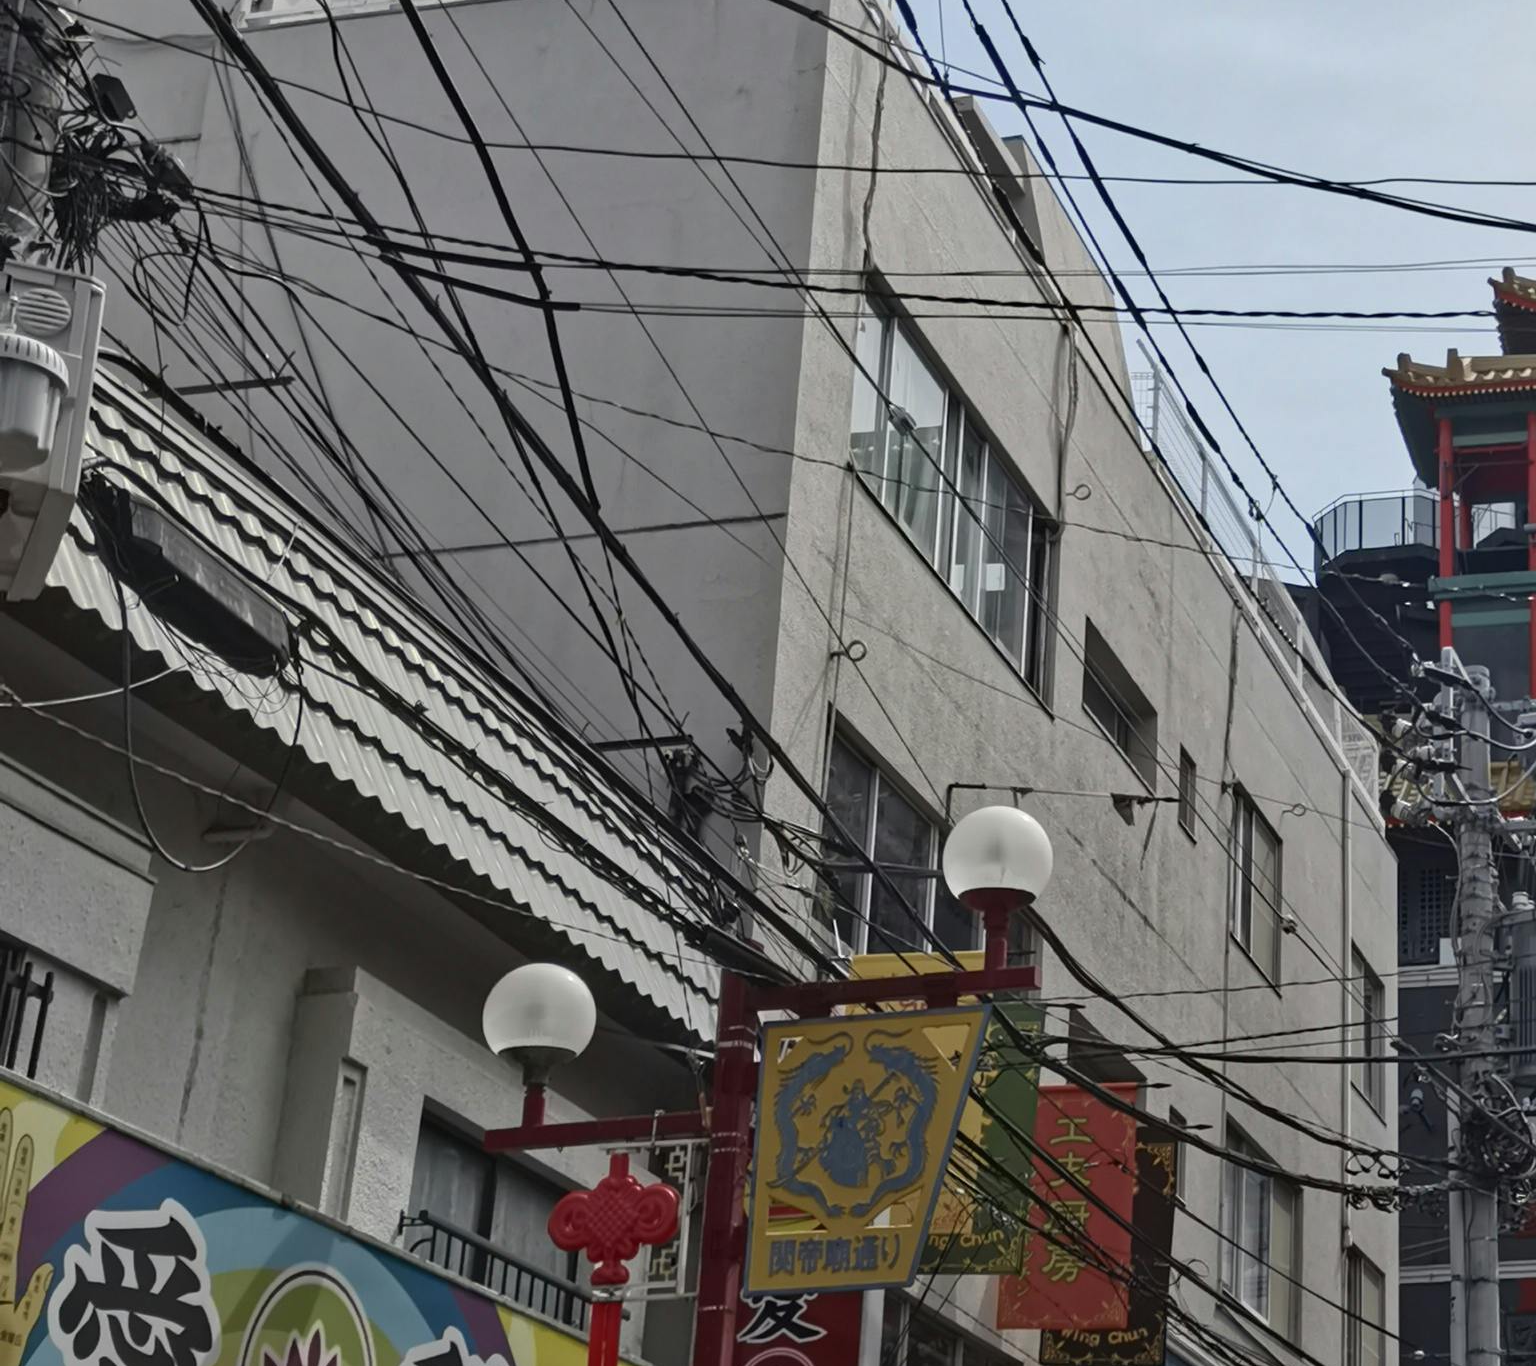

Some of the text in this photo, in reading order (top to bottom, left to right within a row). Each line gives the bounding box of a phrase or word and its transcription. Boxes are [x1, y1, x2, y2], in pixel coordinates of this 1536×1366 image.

[769, 1233, 900, 1278] 関帝廟通り
